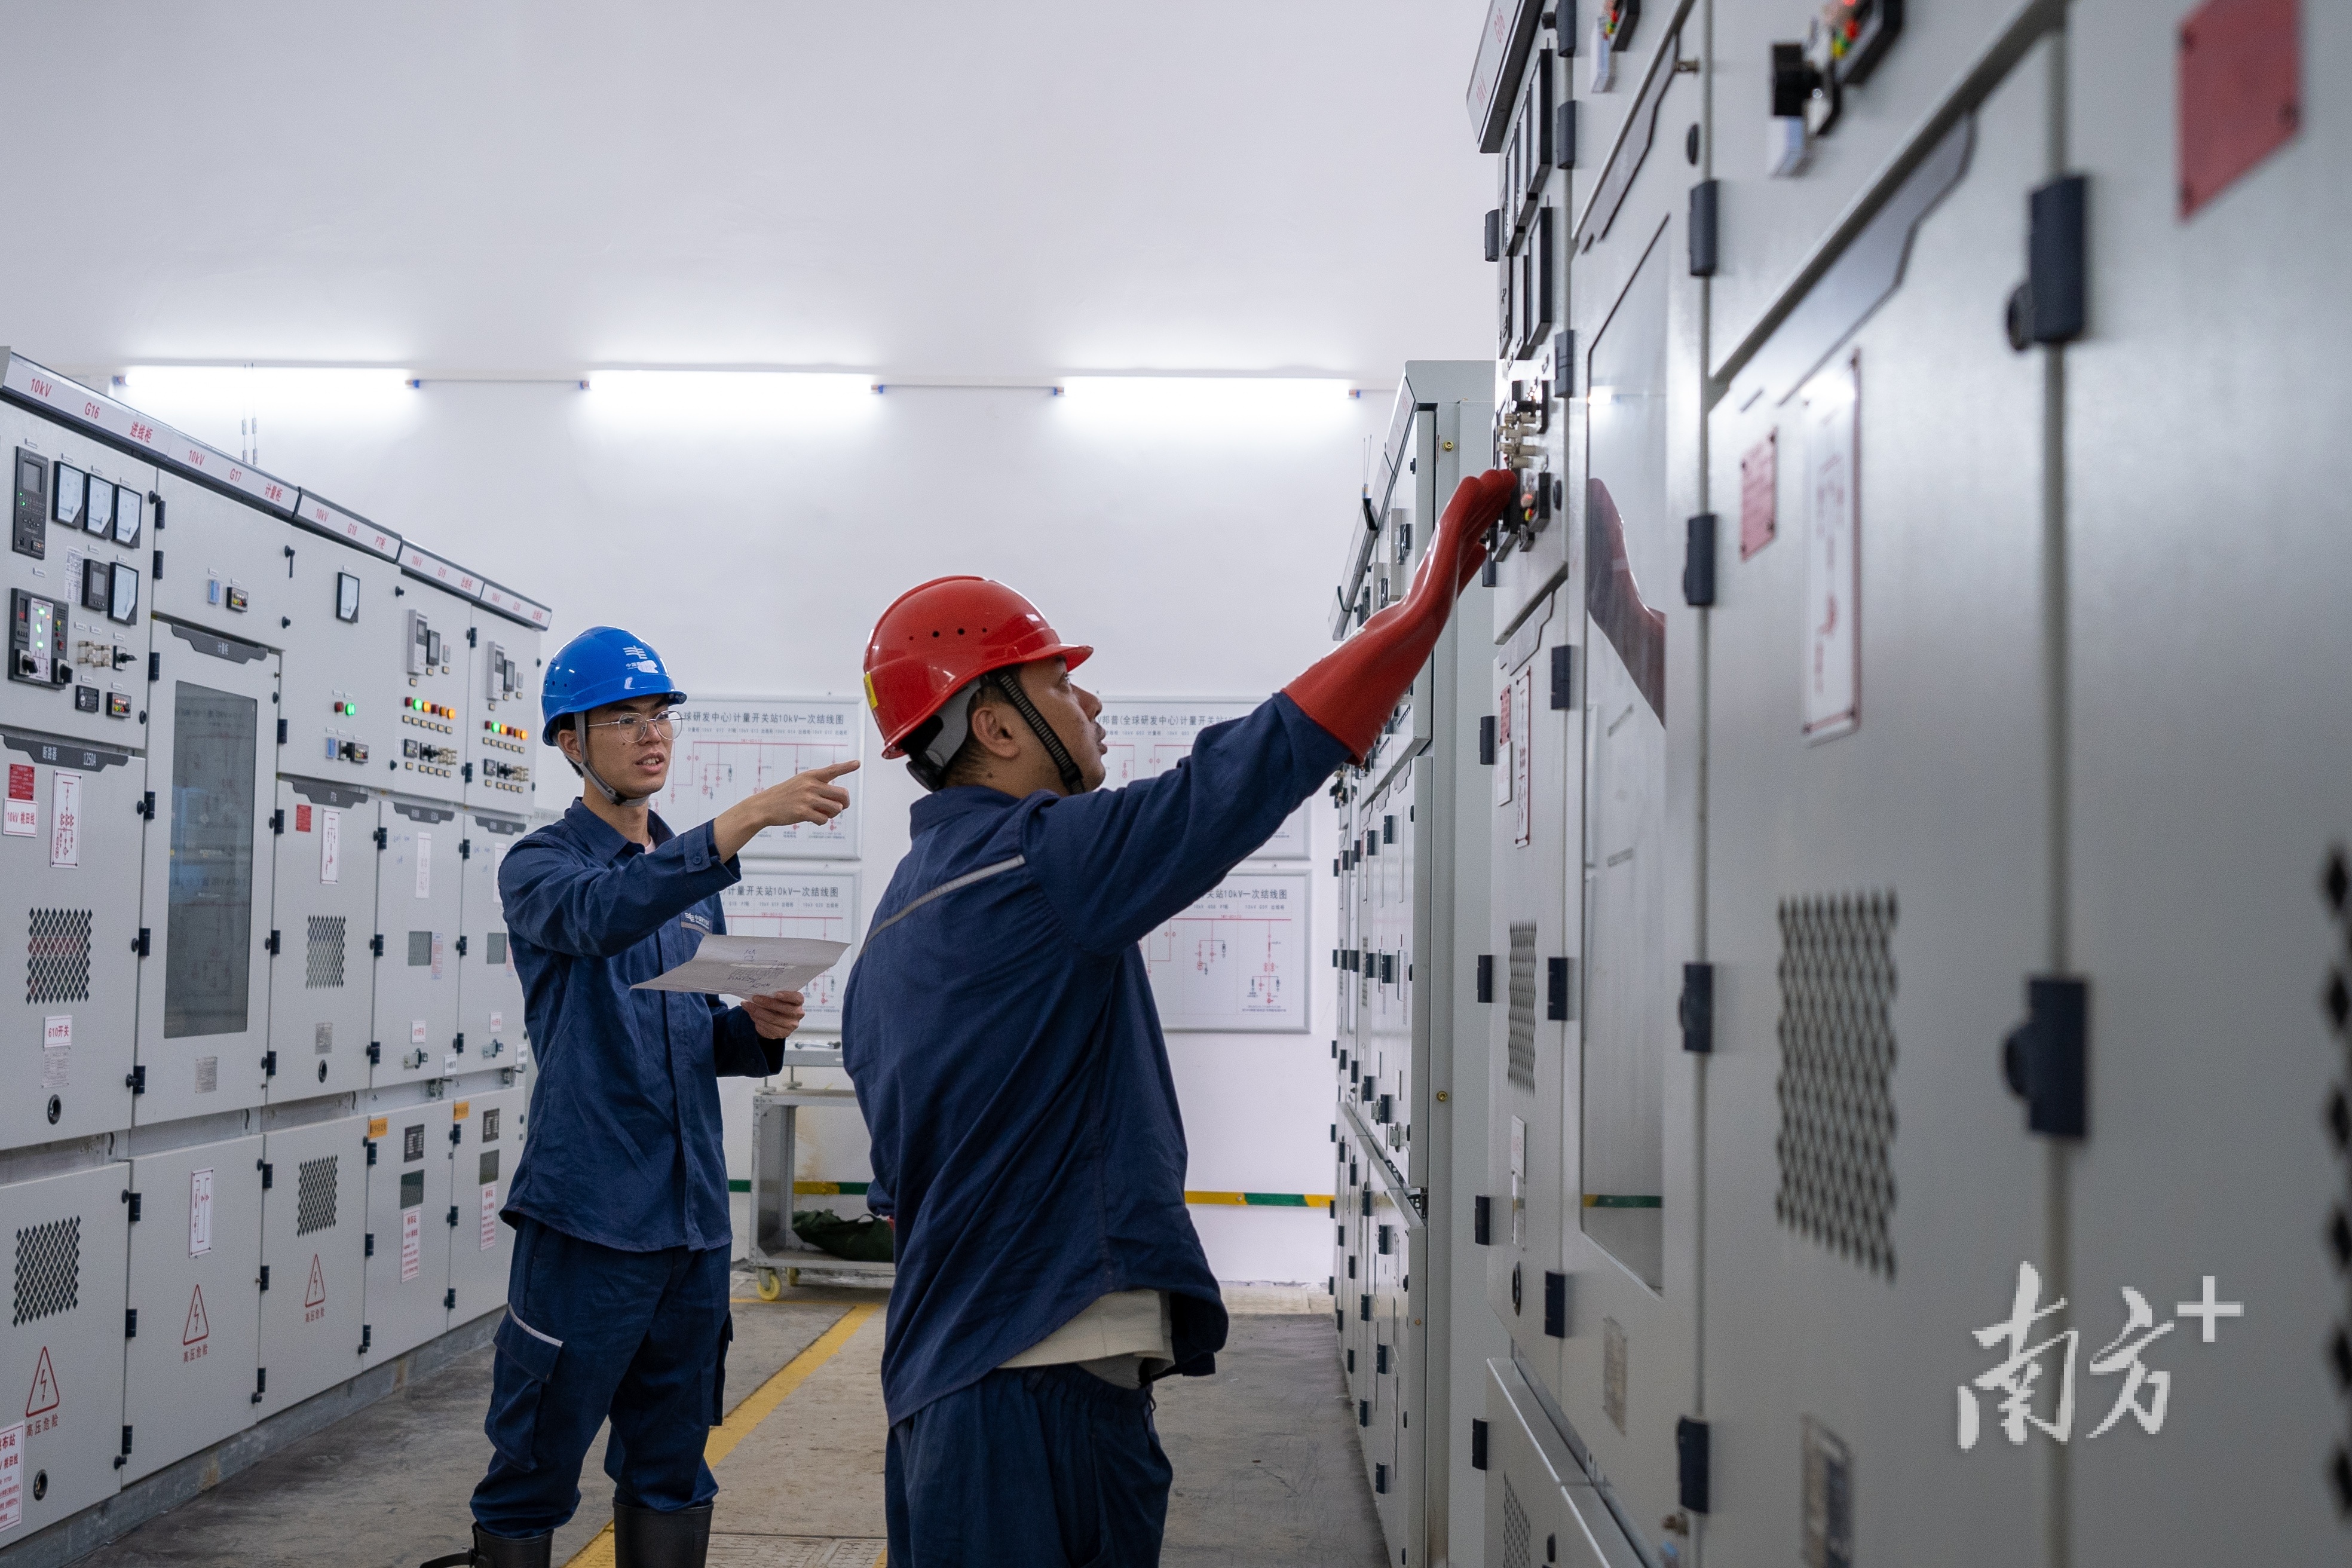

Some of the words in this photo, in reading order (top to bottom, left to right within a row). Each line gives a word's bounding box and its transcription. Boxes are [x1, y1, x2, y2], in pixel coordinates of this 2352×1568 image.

[30, 378, 52, 398] 10kV
[85, 402, 100, 419] G16
[130, 421, 153, 443] 进线柜
[188, 449, 205, 466] 10kV
[229, 468, 242, 483] G17
[265, 483, 283, 502] 计量柜
[316, 509, 329, 522] 10kV
[348, 523, 358, 536] G18
[375, 536, 386, 549] PT柜
[412, 555, 423, 567] 10kV
[678, 711, 844, 725] 球研发中心)计量开关站10kV一次结线图
[1098, 715, 1232, 725] V邦普(全球研发中心)计量开关站
[1201, 889, 1287, 899] 关站10kV一次结线图
[48, 1025, 69, 1038] 610开关
[183, 1344, 208, 1364] 高压危险
[26, 1413, 59, 1438] 高压危险
